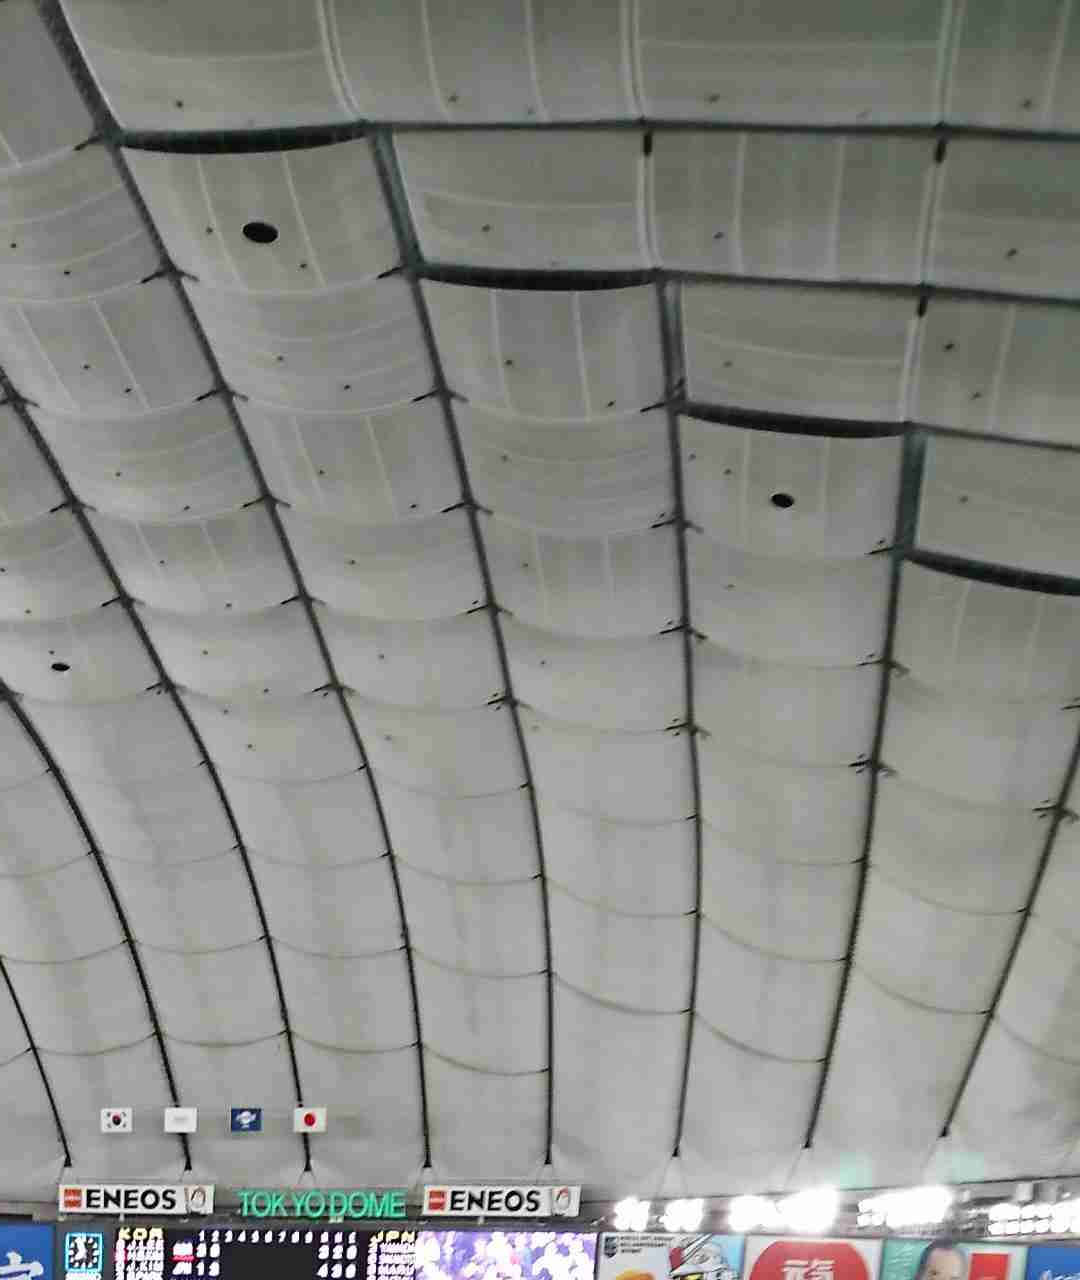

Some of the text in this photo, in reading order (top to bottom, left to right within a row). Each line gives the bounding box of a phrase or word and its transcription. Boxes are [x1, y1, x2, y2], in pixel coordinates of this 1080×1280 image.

[86, 1188, 177, 1210] ENEOS
[238, 1190, 408, 1217] TOKYO DOME
[449, 1188, 541, 1212] ENEOS
